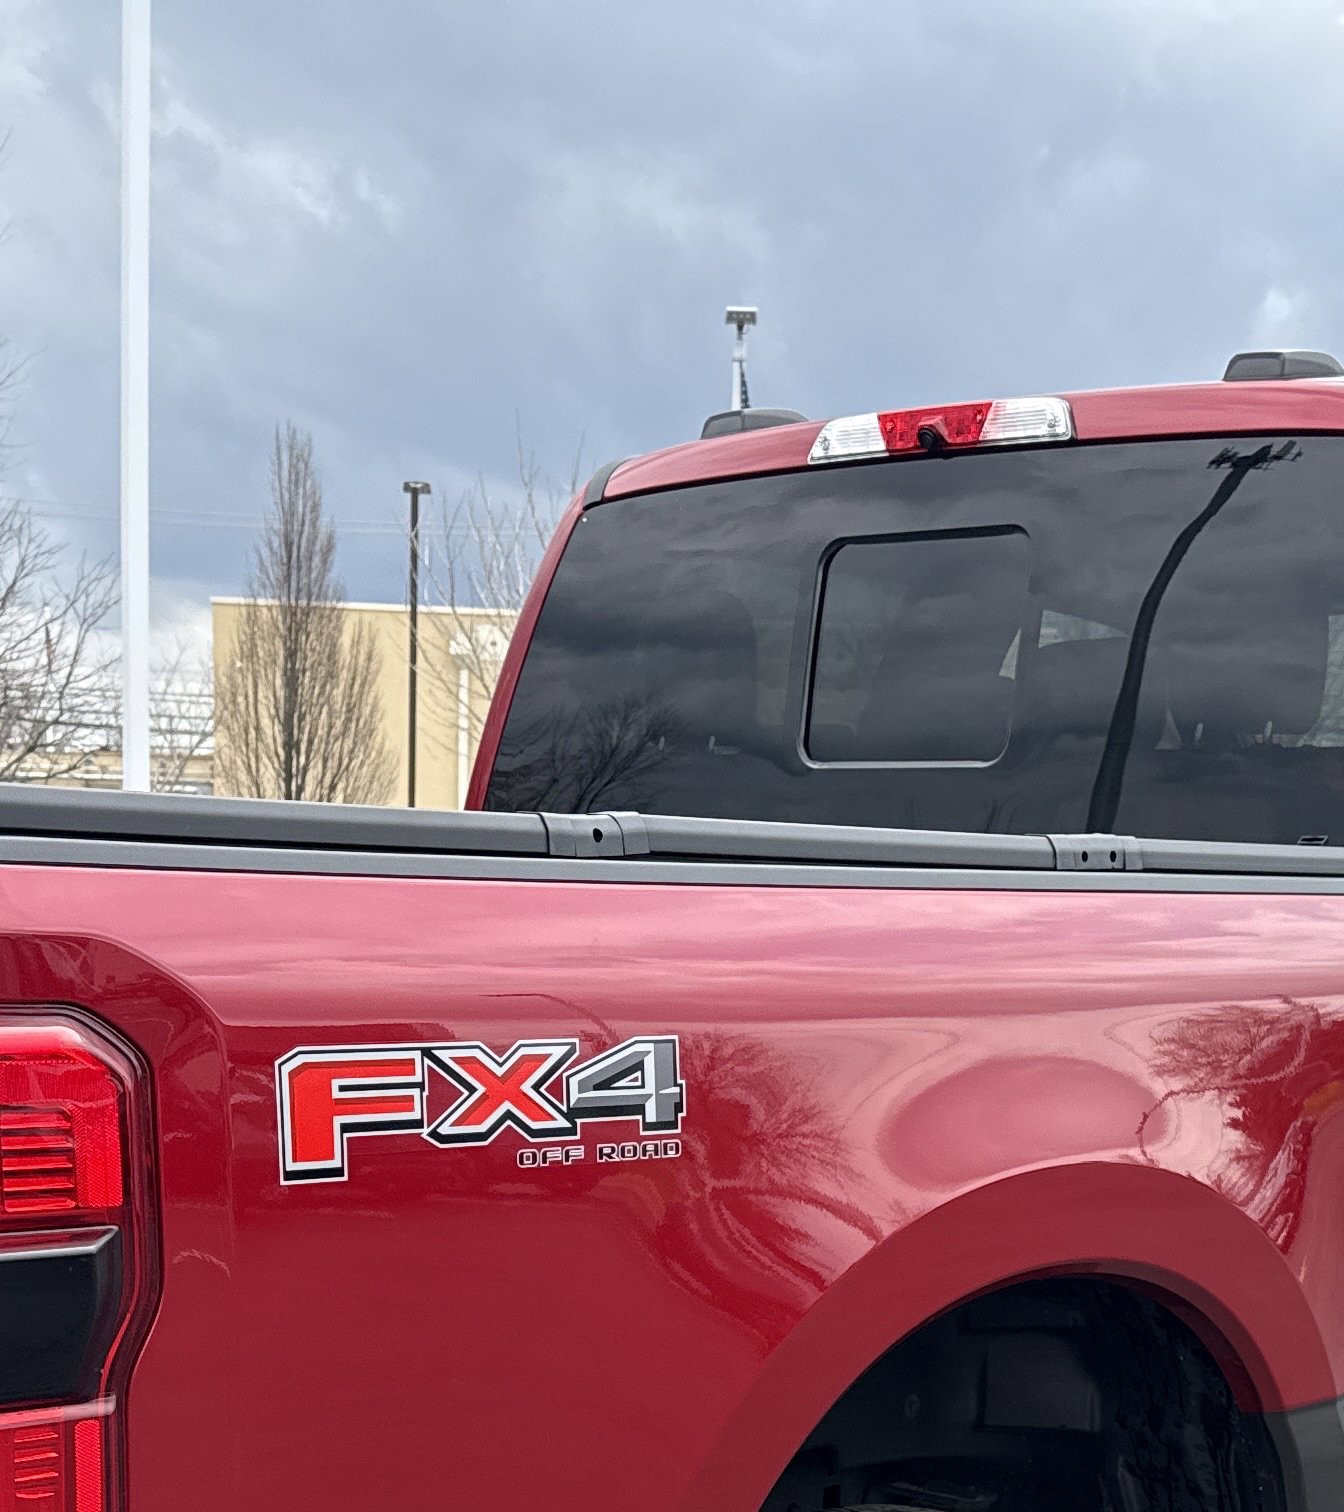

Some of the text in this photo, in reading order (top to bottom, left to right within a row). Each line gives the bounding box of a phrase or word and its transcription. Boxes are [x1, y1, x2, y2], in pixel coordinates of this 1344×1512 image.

[274, 1035, 687, 1186] FX4
[517, 1138, 682, 1169] OFF ROAD
